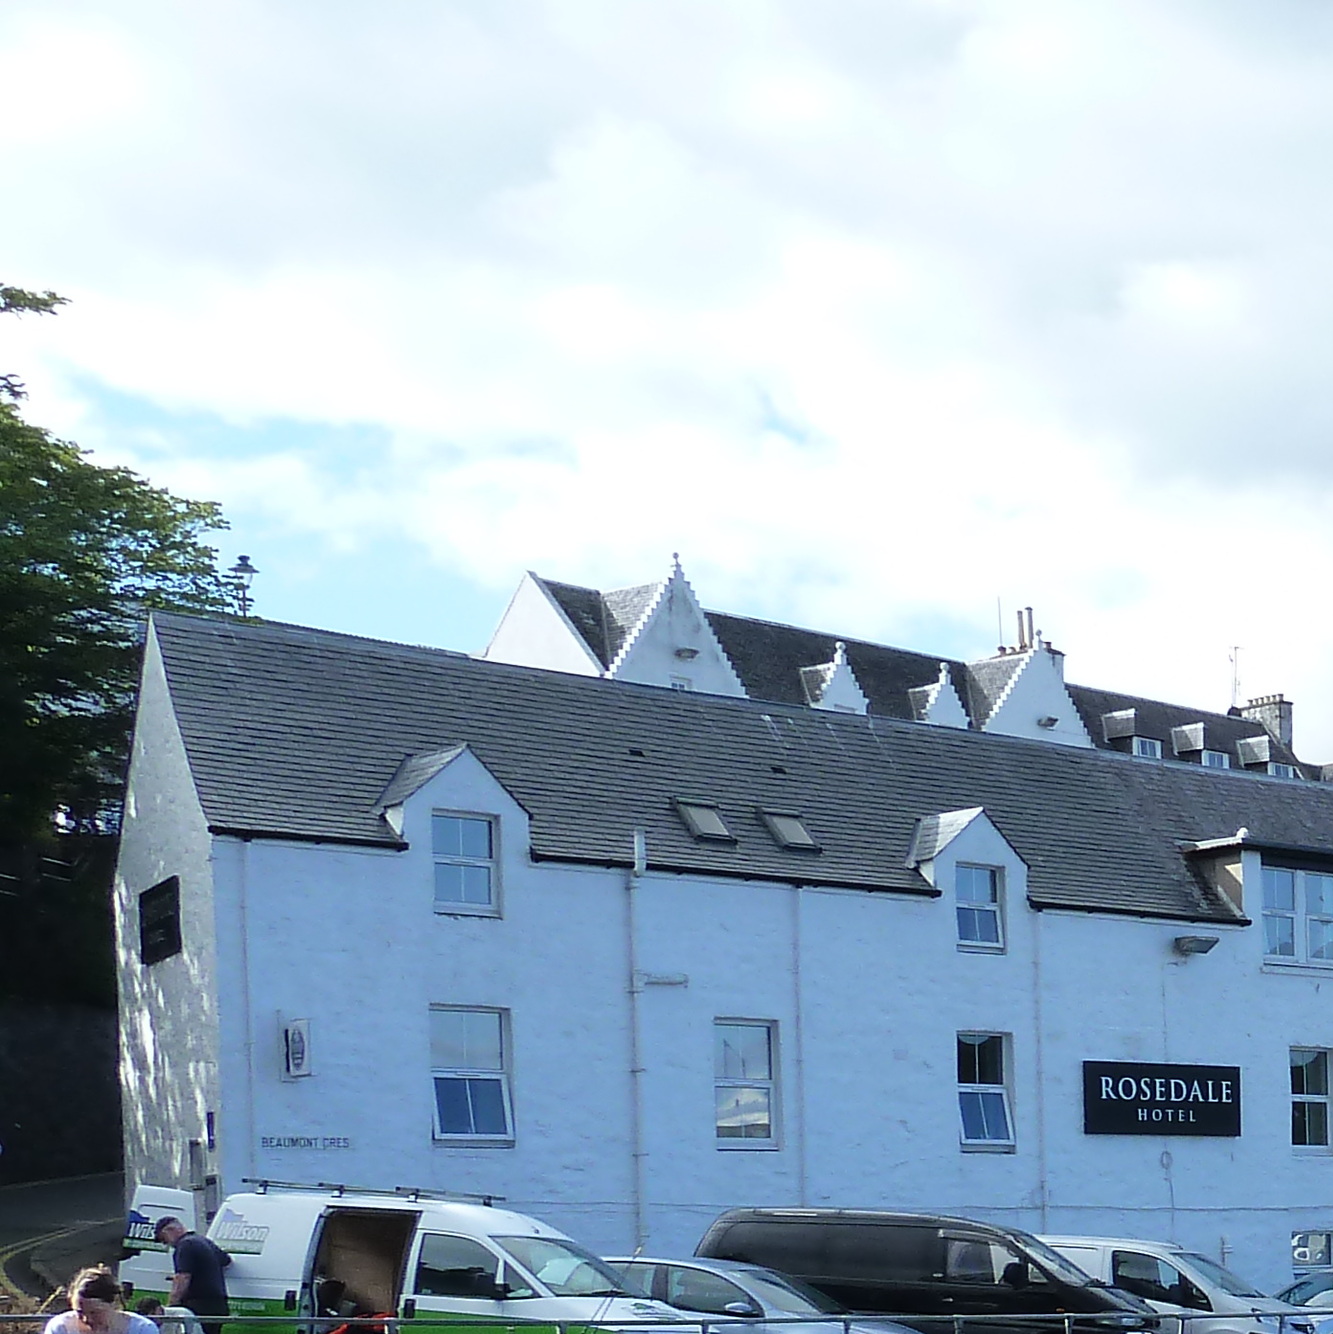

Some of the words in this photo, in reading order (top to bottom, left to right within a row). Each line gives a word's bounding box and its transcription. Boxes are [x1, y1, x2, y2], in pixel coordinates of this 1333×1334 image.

[1100, 1076, 1232, 1103] ROSEDALE
[1138, 1108, 1197, 1122] HOTEL
[261, 1136, 319, 1148] BEAUMONT
[129, 1222, 156, 1239] Wils
[217, 1221, 268, 1241] Wilson
